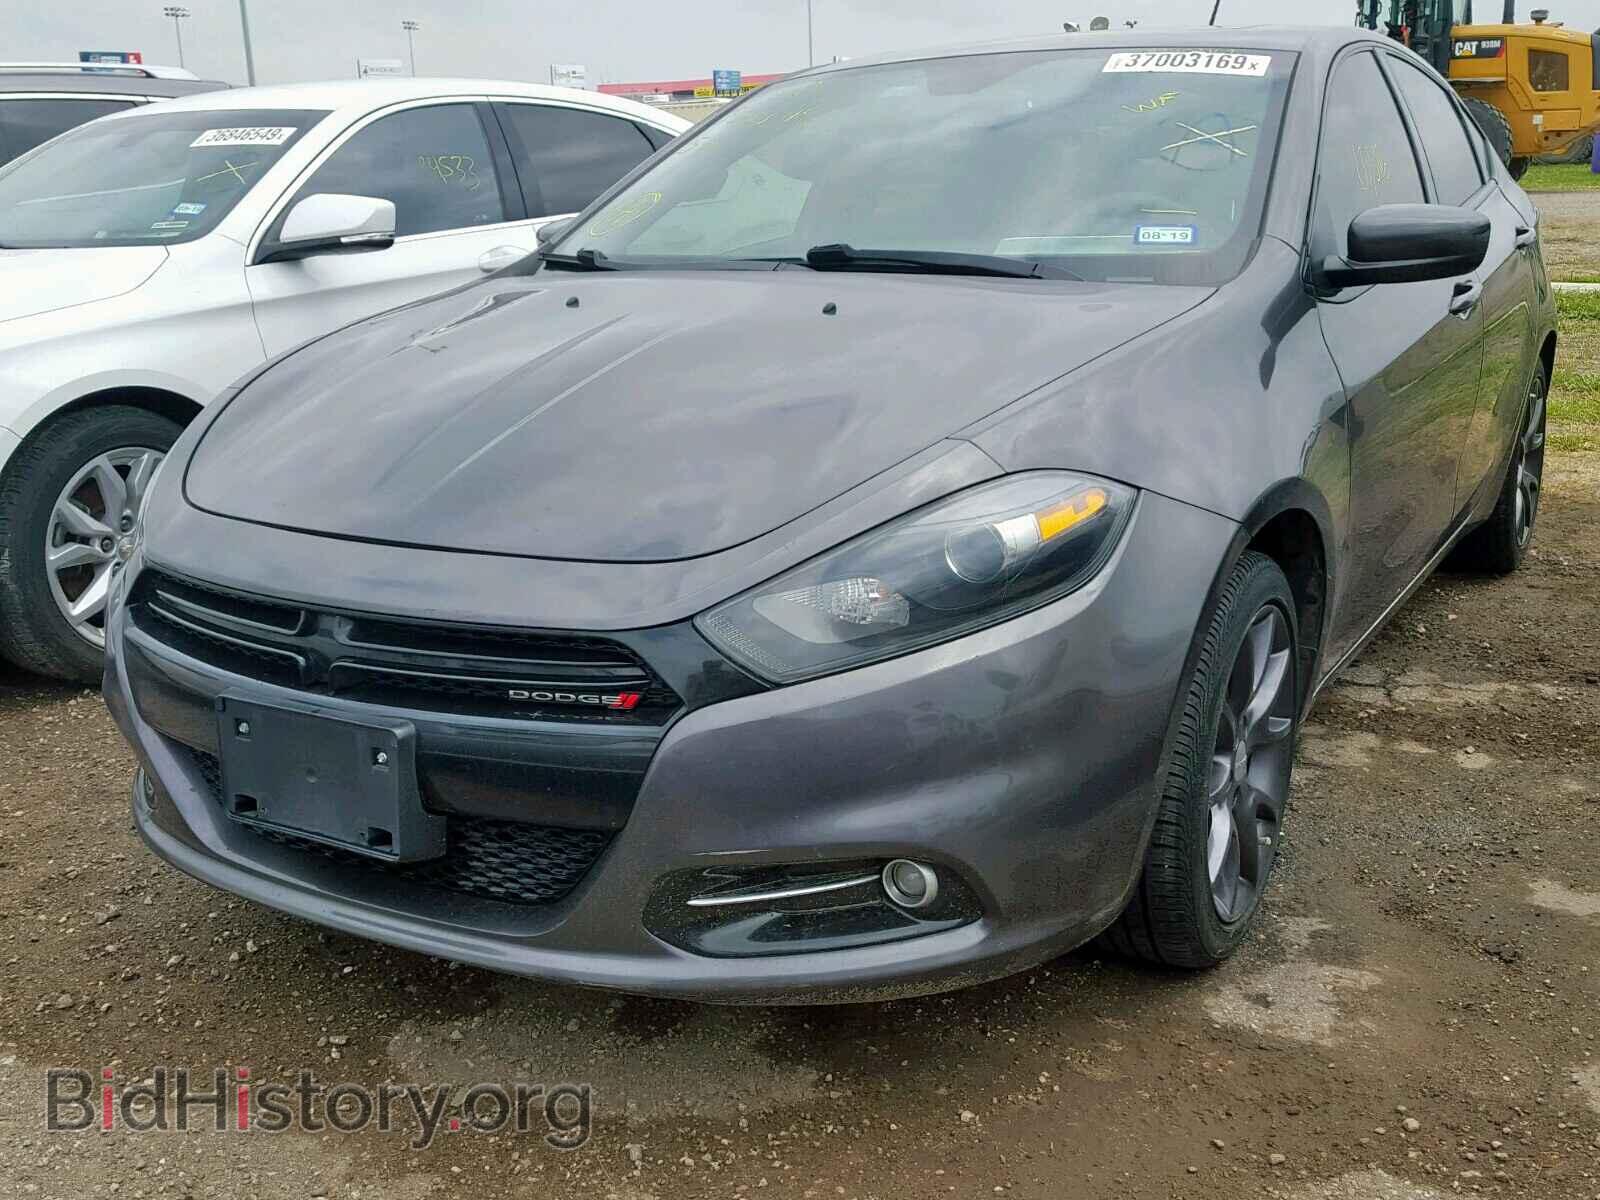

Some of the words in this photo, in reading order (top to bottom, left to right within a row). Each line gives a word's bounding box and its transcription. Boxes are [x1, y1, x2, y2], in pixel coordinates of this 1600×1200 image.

[1454, 41, 1479, 57] CAT
[1124, 52, 1248, 70] 37003169
[1142, 231, 1189, 240] 08-19
[507, 689, 624, 706] DODGE
